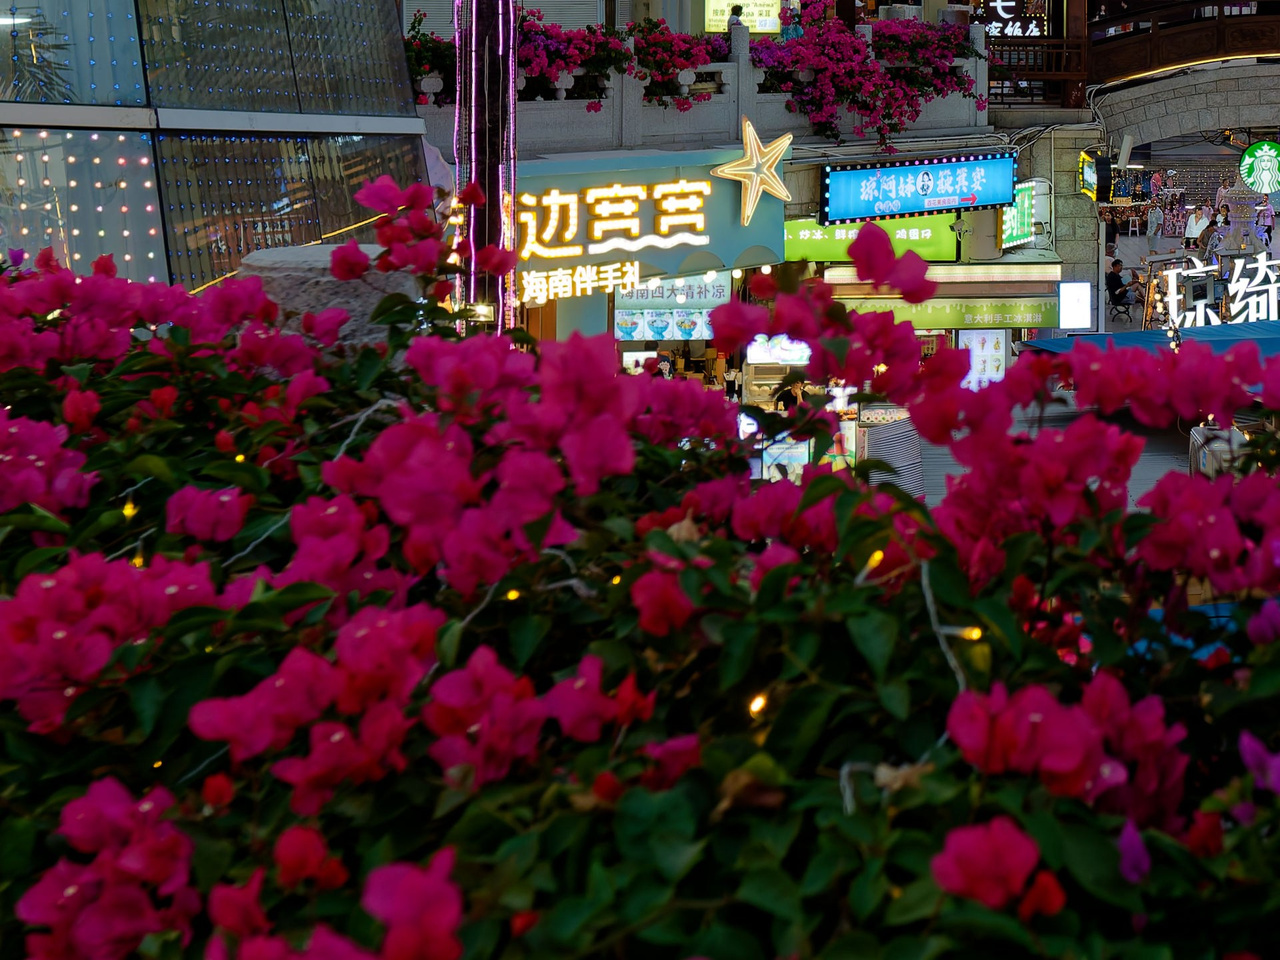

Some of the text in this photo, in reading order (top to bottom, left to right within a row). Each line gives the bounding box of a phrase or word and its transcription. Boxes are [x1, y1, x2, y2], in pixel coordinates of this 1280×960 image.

[896, 229, 932, 240] 鸡蛋仔
[521, 261, 646, 304] 海南伴手礼
[621, 284, 726, 300] 海南四大清补凉
[964, 312, 1043, 325] 意大利手工冰淇淋
